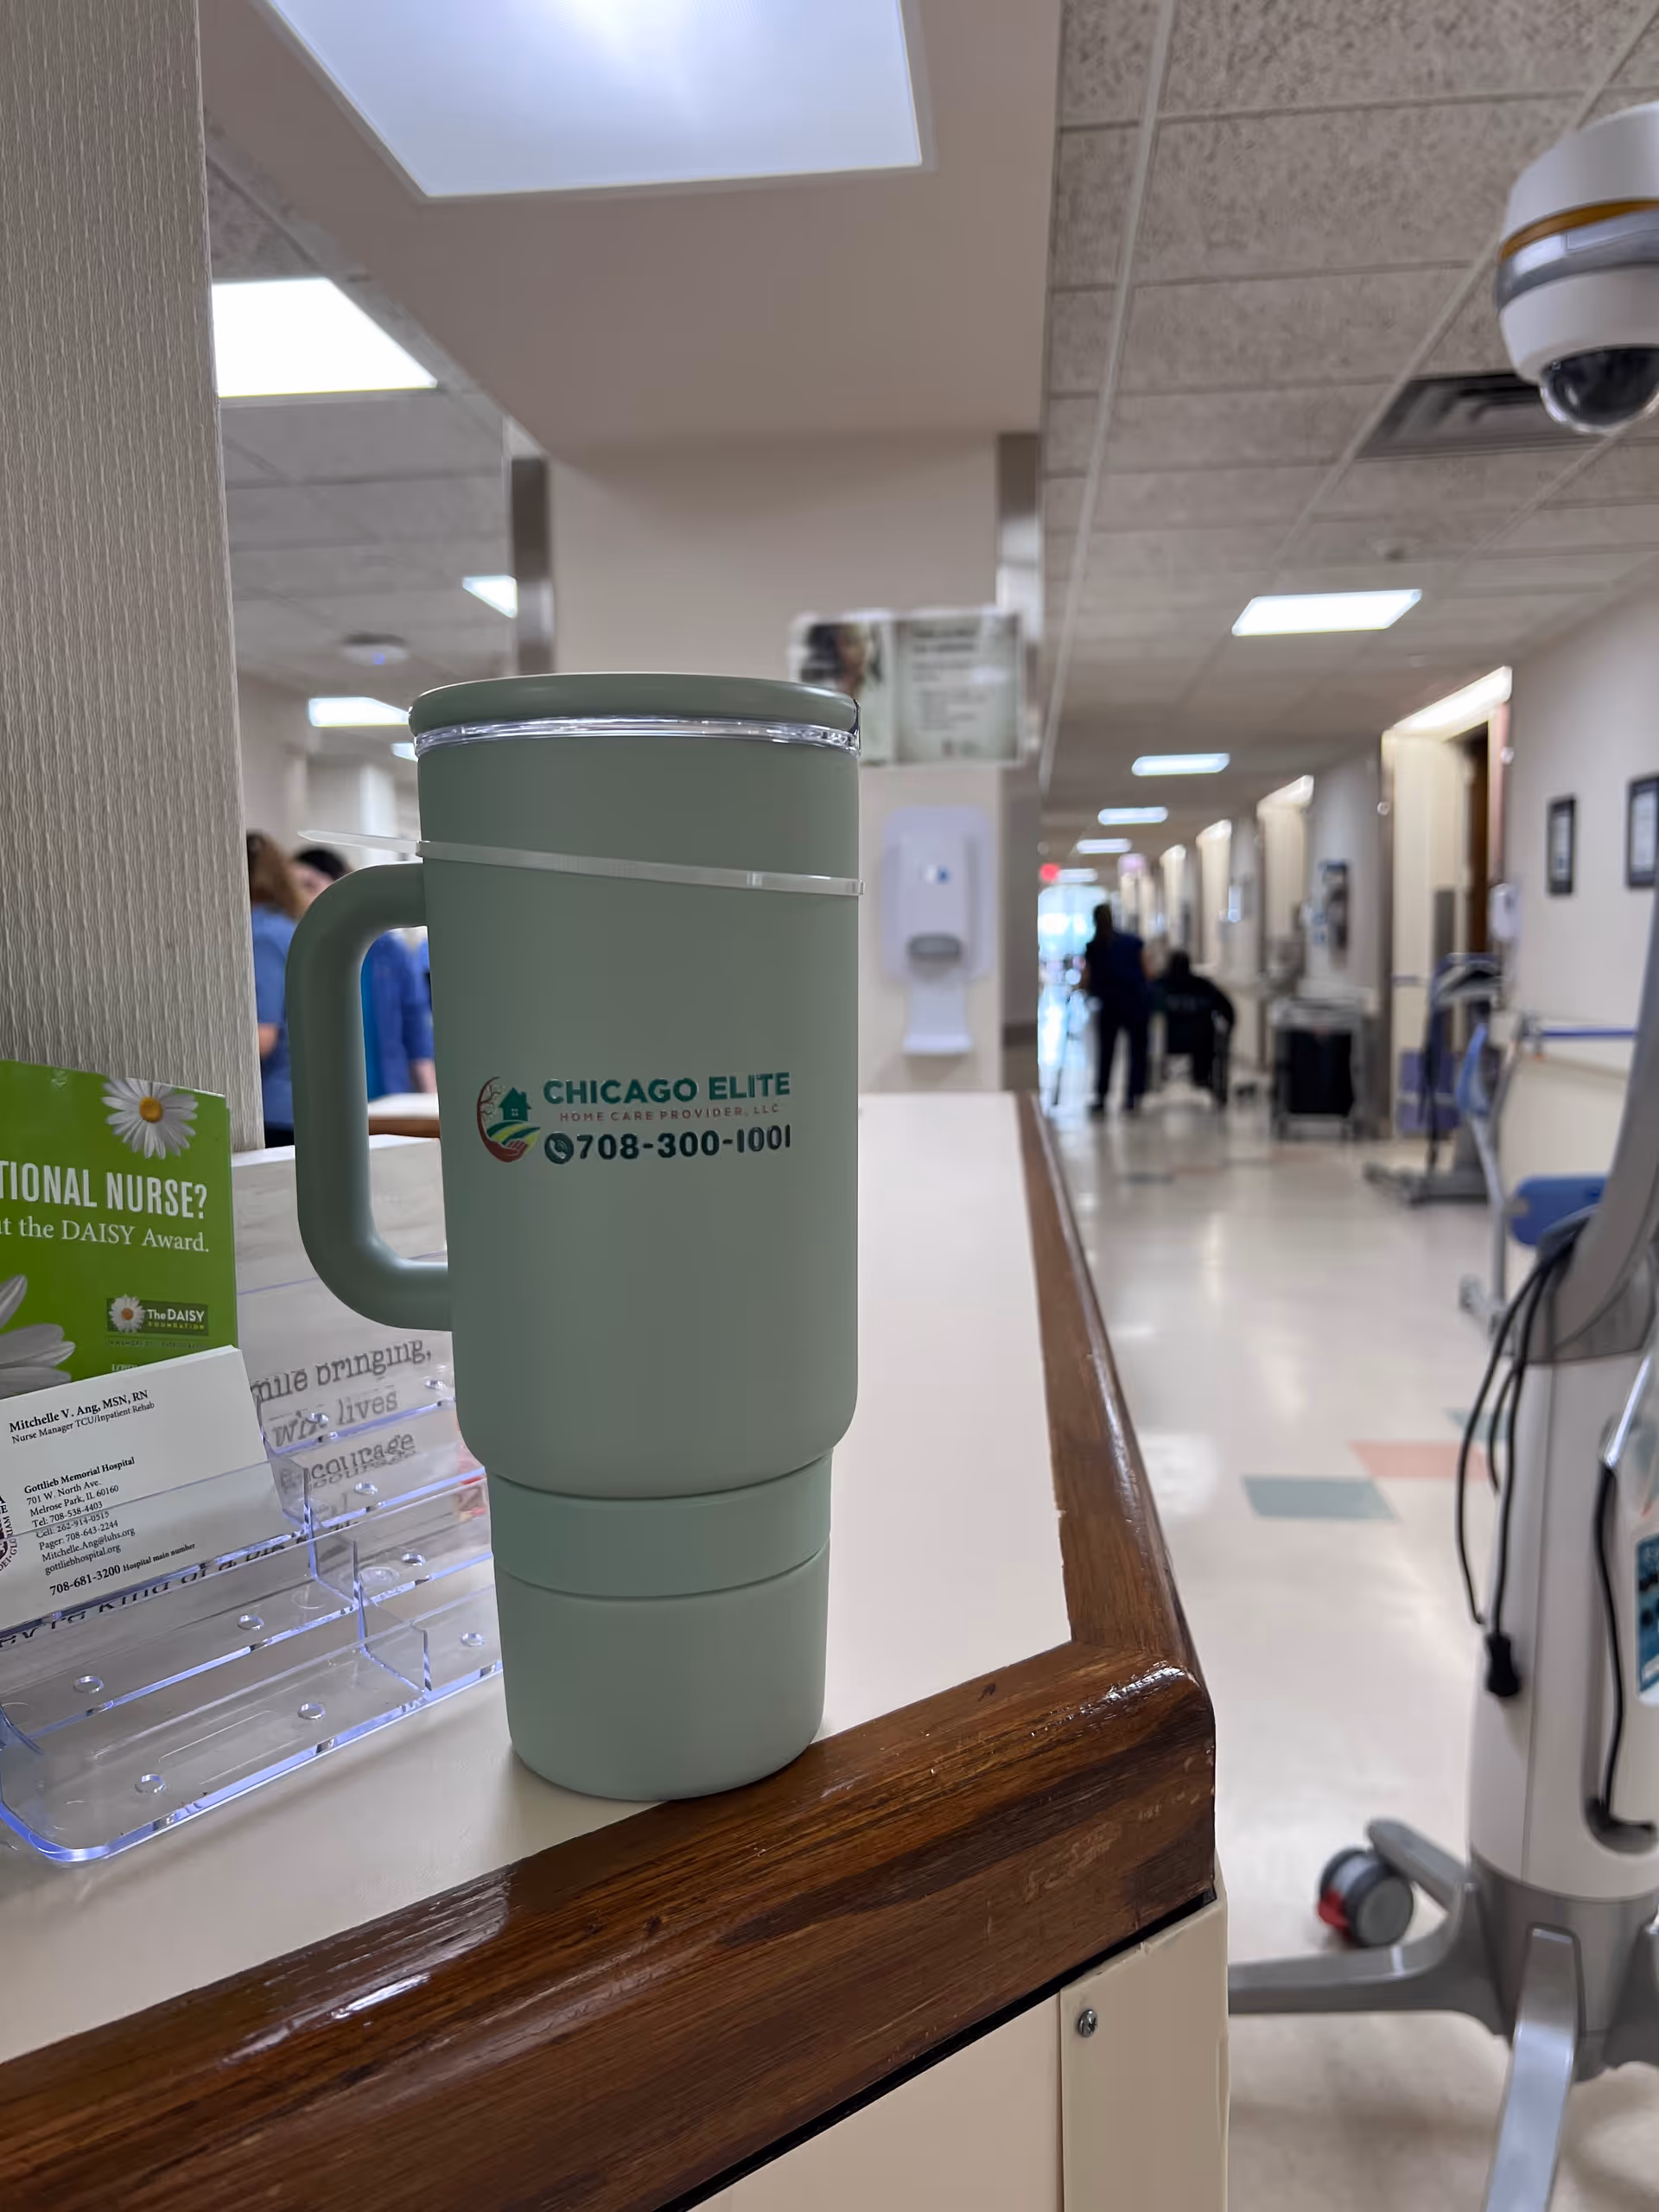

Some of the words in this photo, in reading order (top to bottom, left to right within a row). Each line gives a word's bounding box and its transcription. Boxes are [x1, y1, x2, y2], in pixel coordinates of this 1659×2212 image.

[543, 1077, 699, 1105] CHICAGO
[709, 1071, 791, 1101] ELITE
[560, 1110, 604, 1122] HOME
[610, 1110, 653, 1122] CARE
[753, 1103, 780, 1115] LLC
[576, 1123, 791, 1160] 708-300-1001
[106, 1171, 208, 1219] NURSE?
[19, 1216, 54, 1238] the
[61, 1219, 137, 1245] DAISY
[142, 1228, 209, 1253] Award.
[168, 1307, 205, 1322] DAISY
[9, 1412, 60, 1433] Mitchelle
[60, 1409, 74, 1419] V.
[76, 1404, 101, 1416] Ang,
[102, 1394, 131, 1410] MSN,
[132, 1389, 149, 1402] RN
[11, 1432, 37, 1444] Nurse
[39, 1423, 73, 1437] Manager
[74, 1408, 131, 1427] TCU/Inpatient
[132, 1401, 155, 1414] Rehab
[24, 1478, 60, 1494] Gottlieb
[60, 1466, 101, 1484] Memorial
[101, 1456, 136, 1473] Hospital
[26, 1495, 41, 1506] 701
[43, 1491, 56, 1501] W.
[57, 1483, 82, 1497] North
[84, 1480, 101, 1491] Ave.
[29, 1503, 62, 1517] Melrose
[64, 1495, 85, 1508] Park,
[86, 1492, 95, 1501] IL
[96, 1484, 119, 1497] 60160
[32, 1516, 48, 1528] Tel:
[50, 1501, 103, 1523] 708-538-4403
[36, 1528, 54, 1538] Cell:
[39, 1538, 66, 1551] Pager:
[66, 1520, 118, 1541] 708-643-2244
[41, 1528, 136, 1562] Mitchelle.Ang@luhs.org
[45, 1544, 121, 1576] gottliebhospital.org
[49, 1565, 121, 1596] 708-681-3200
[123, 1557, 151, 1572] Hospital
[153, 1551, 170, 1562] main
[170, 1541, 196, 1556] number
